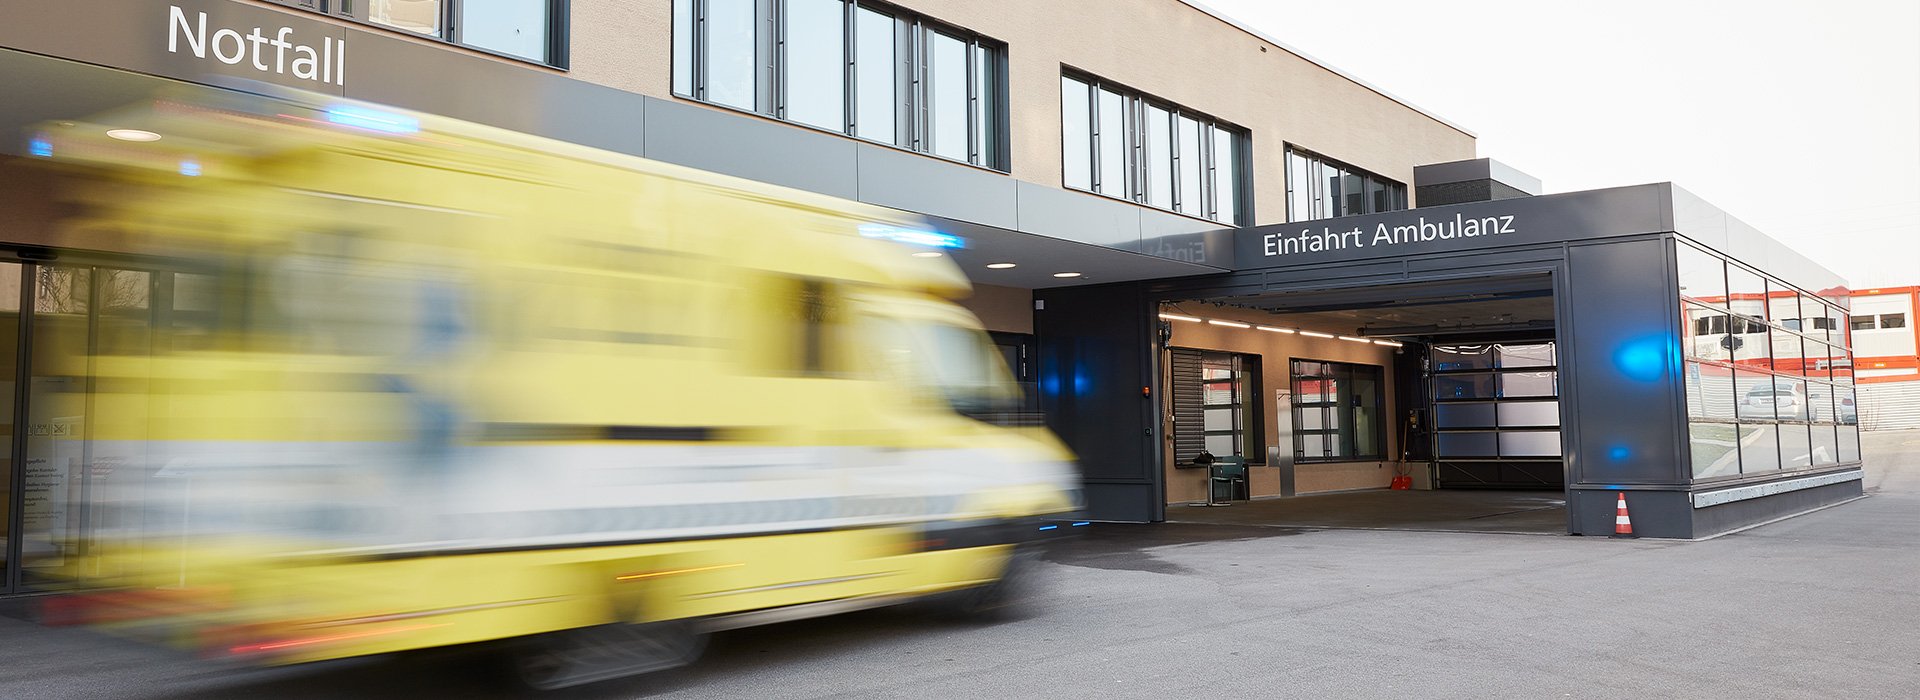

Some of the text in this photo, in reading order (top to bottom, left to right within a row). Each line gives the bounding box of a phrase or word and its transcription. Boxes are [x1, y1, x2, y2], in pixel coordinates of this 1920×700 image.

[168, 5, 345, 86] Notfall
[1263, 213, 1516, 257] Einfahrt Ambulanz
